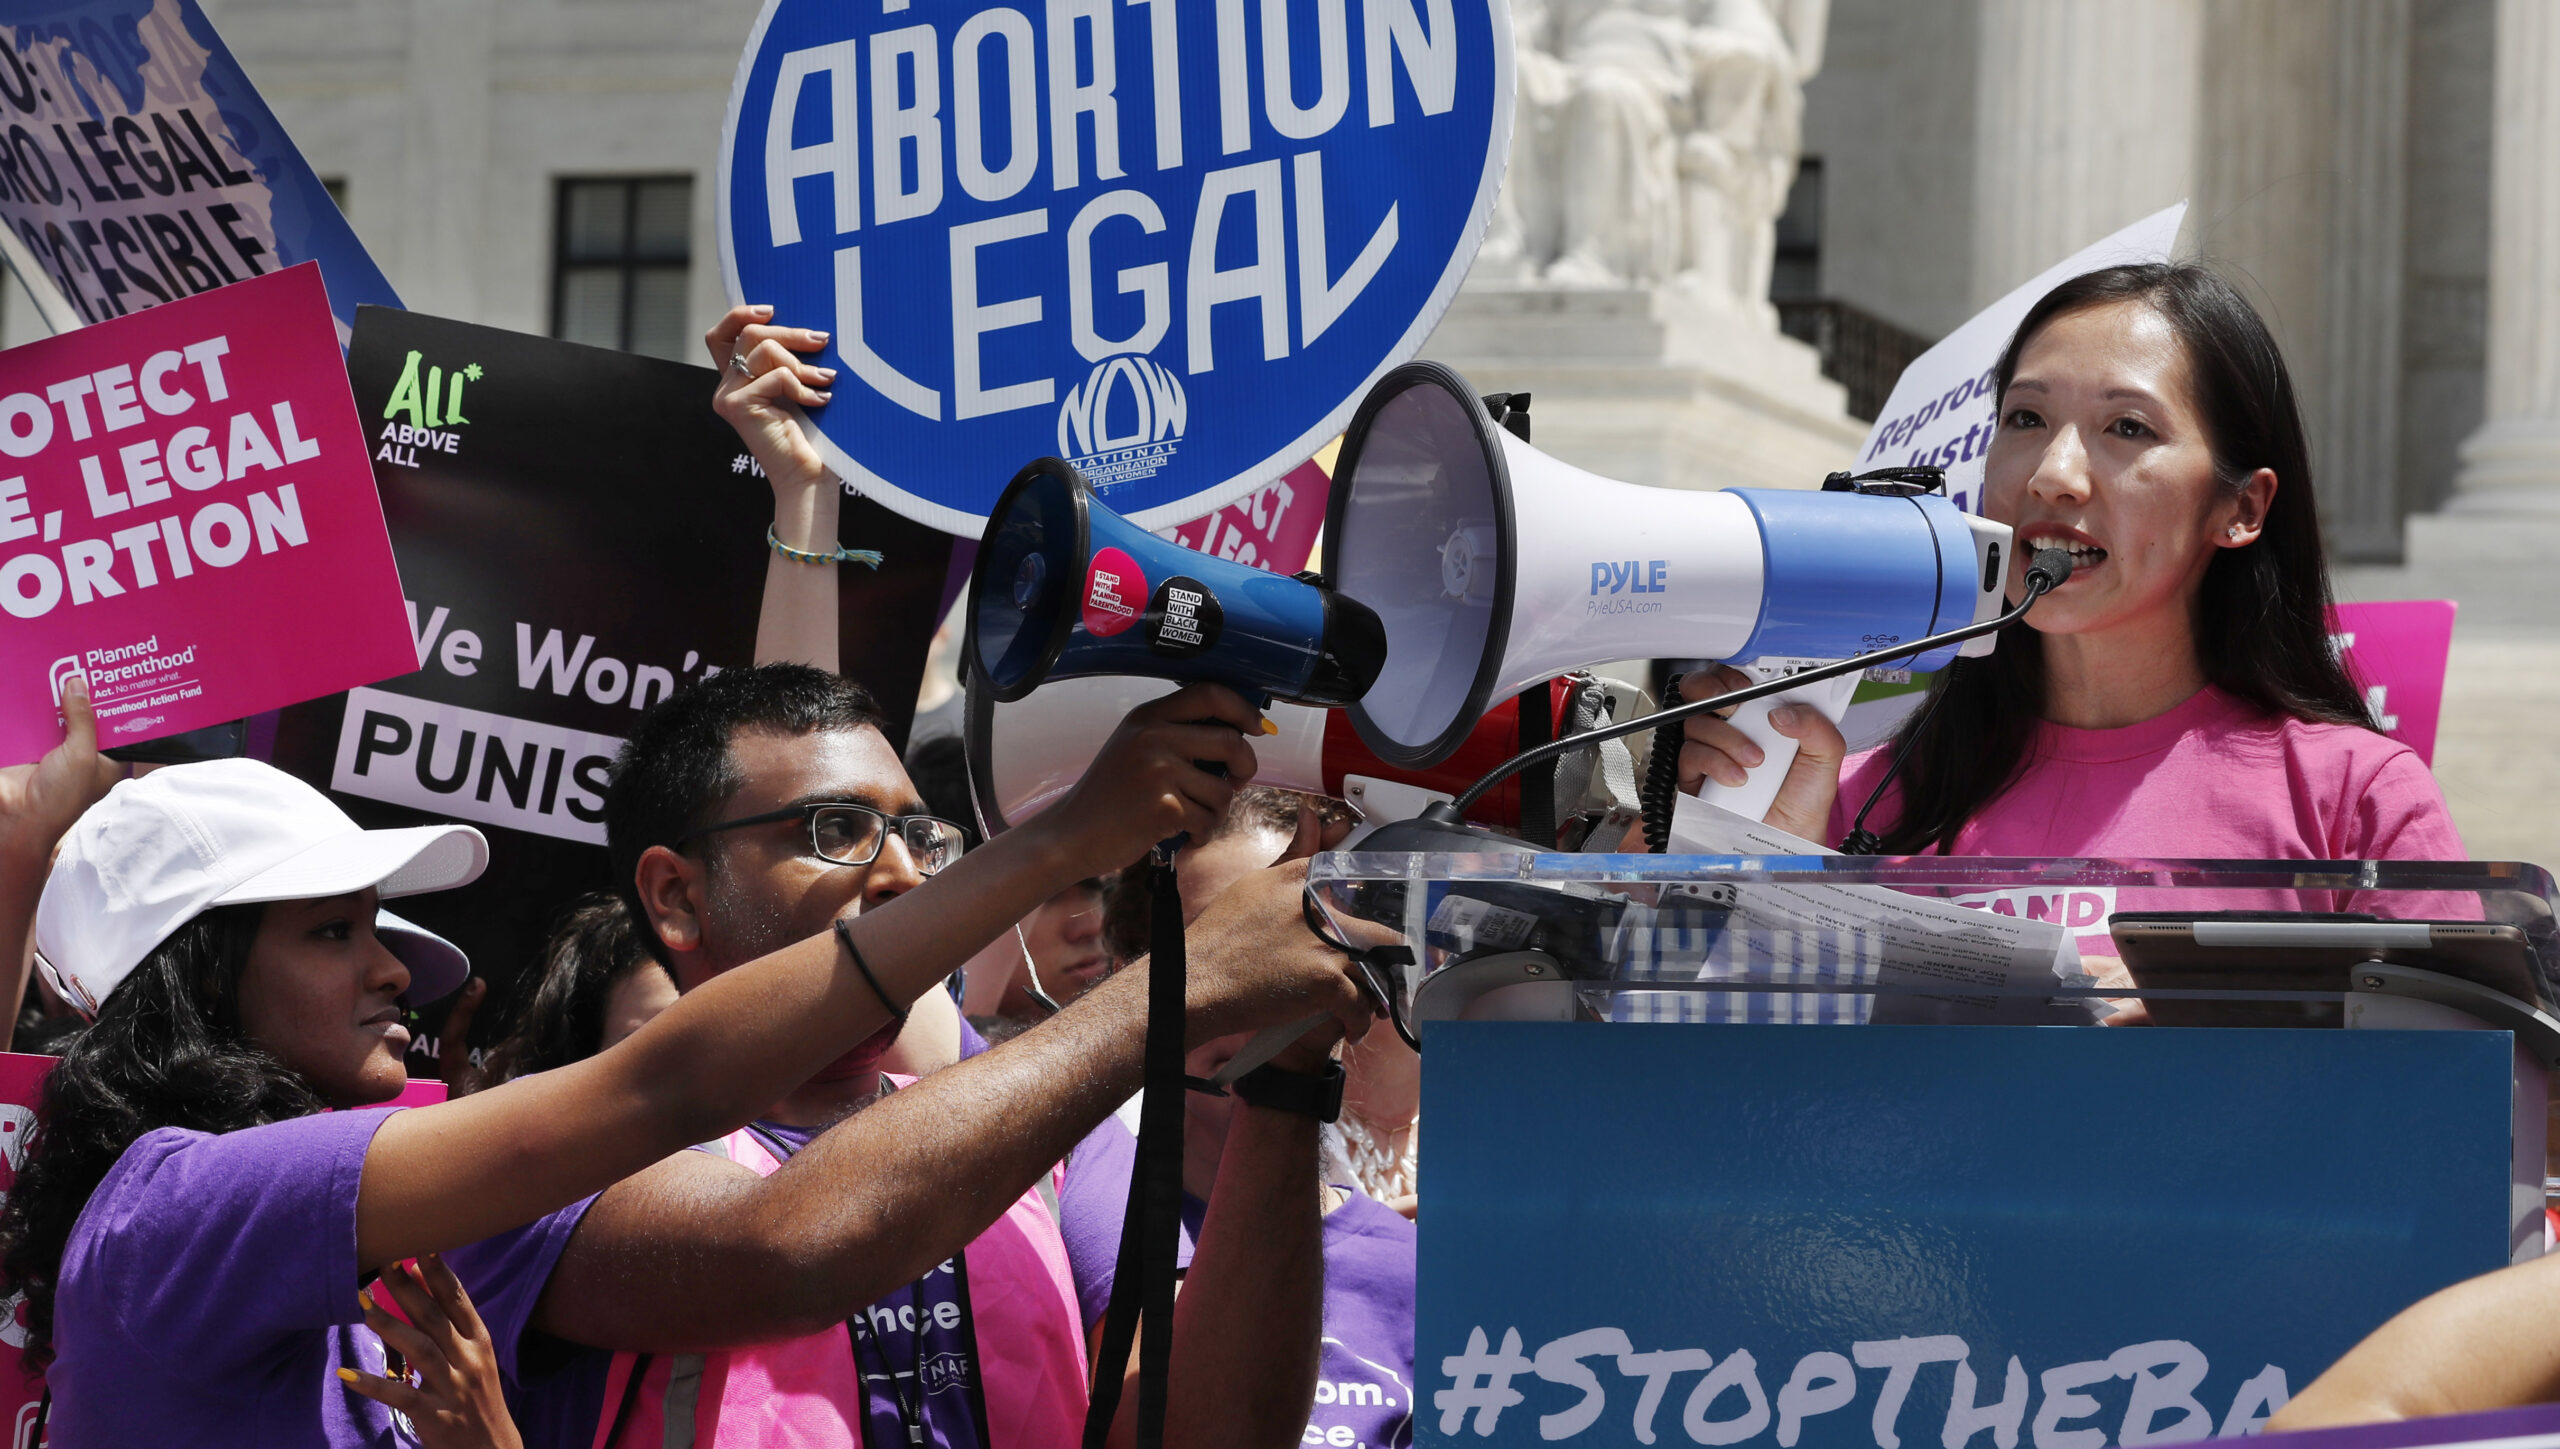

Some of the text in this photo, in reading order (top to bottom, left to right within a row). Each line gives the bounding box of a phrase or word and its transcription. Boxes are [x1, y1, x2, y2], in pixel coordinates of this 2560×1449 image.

[765, 0, 1457, 247] ABORTION
[52, 108, 252, 203] LEGAL
[833, 150, 1399, 421] LEGAL
[0, 335, 230, 458] OTECT
[1057, 357, 1187, 459] NOW
[380, 421, 460, 454] ABOVE
[79, 400, 321, 519] LEGAL
[376, 442, 420, 468] ALL
[1070, 443, 1177, 470] NATIONAL
[1081, 456, 1168, 478] ORGANIZATION
[1092, 467, 1156, 485] FOR WOMEN
[0, 483, 309, 619] ORTION
[1095, 581, 1111, 591] WITH
[1099, 572, 1119, 584] STAND
[1590, 560, 1667, 596] PYLE
[1090, 598, 1132, 616] PARENTHOOD
[1093, 589, 1121, 602] PLANNED
[1168, 602, 1194, 616] WITH
[1170, 589, 1202, 604] STAND
[1586, 599, 1662, 618] PyleUSA.com
[1161, 627, 1201, 643] WOMEN
[1165, 615, 1196, 630] BLACK
[86, 635, 158, 667] Planned
[90, 645, 195, 686] Parenthood
[94, 671, 182, 699] Act. No matter what.
[96, 685, 203, 718] Parenthood Action Fund
[353, 710, 611, 824] PUNIS
